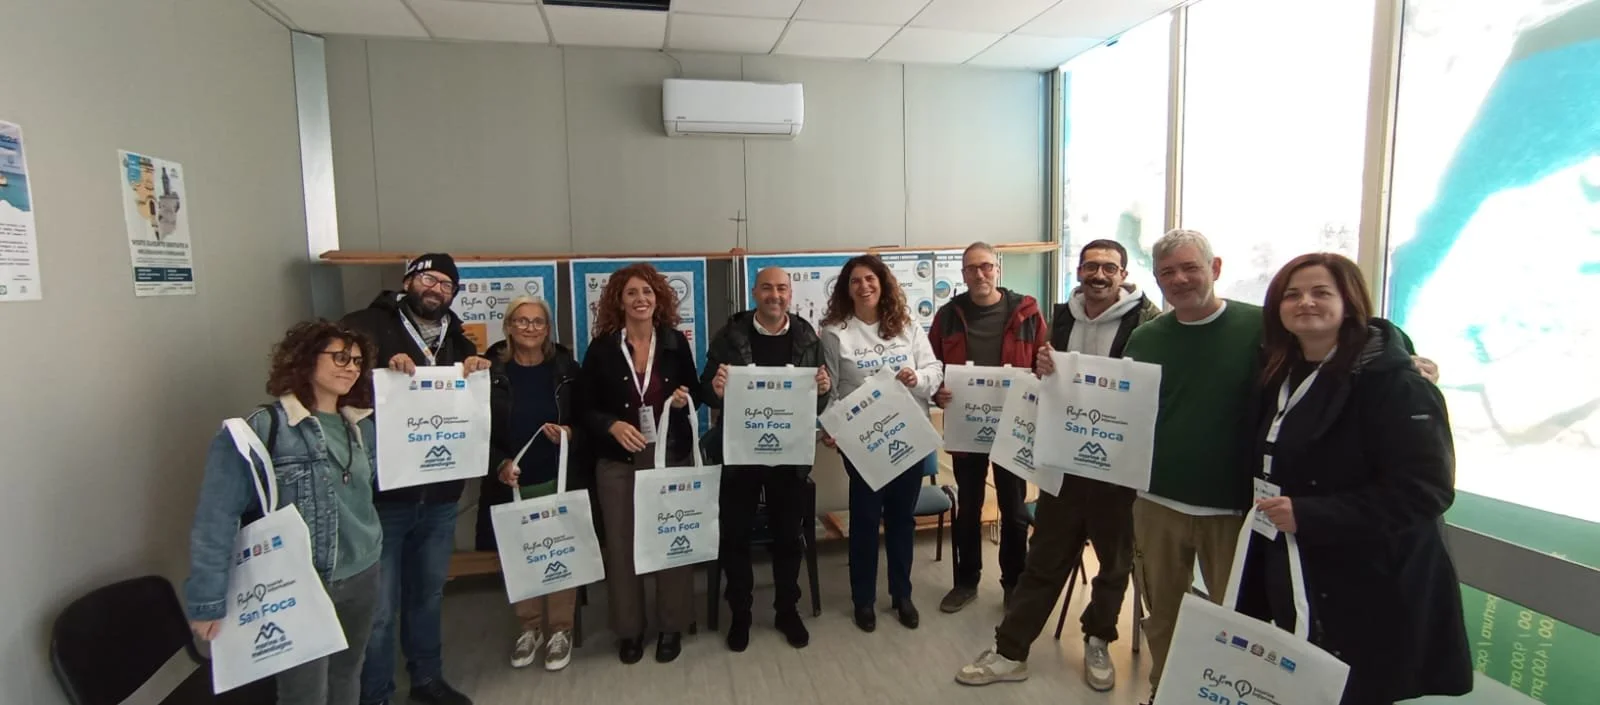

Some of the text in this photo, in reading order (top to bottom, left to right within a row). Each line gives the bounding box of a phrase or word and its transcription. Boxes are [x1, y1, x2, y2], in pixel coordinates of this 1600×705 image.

[463, 311, 505, 321] San Fo
[857, 353, 908, 370] San Foca
[744, 420, 791, 429] San Foca
[965, 414, 983, 422] San
[408, 431, 466, 442] San Foca
[867, 422, 906, 452] San Foca
[1012, 429, 1027, 441] San
[1065, 421, 1124, 442] San Foca
[657, 521, 700, 534] San Foca
[526, 545, 576, 564] San Foca
[239, 596, 297, 626] San Foca
[1198, 686, 1231, 705] San
